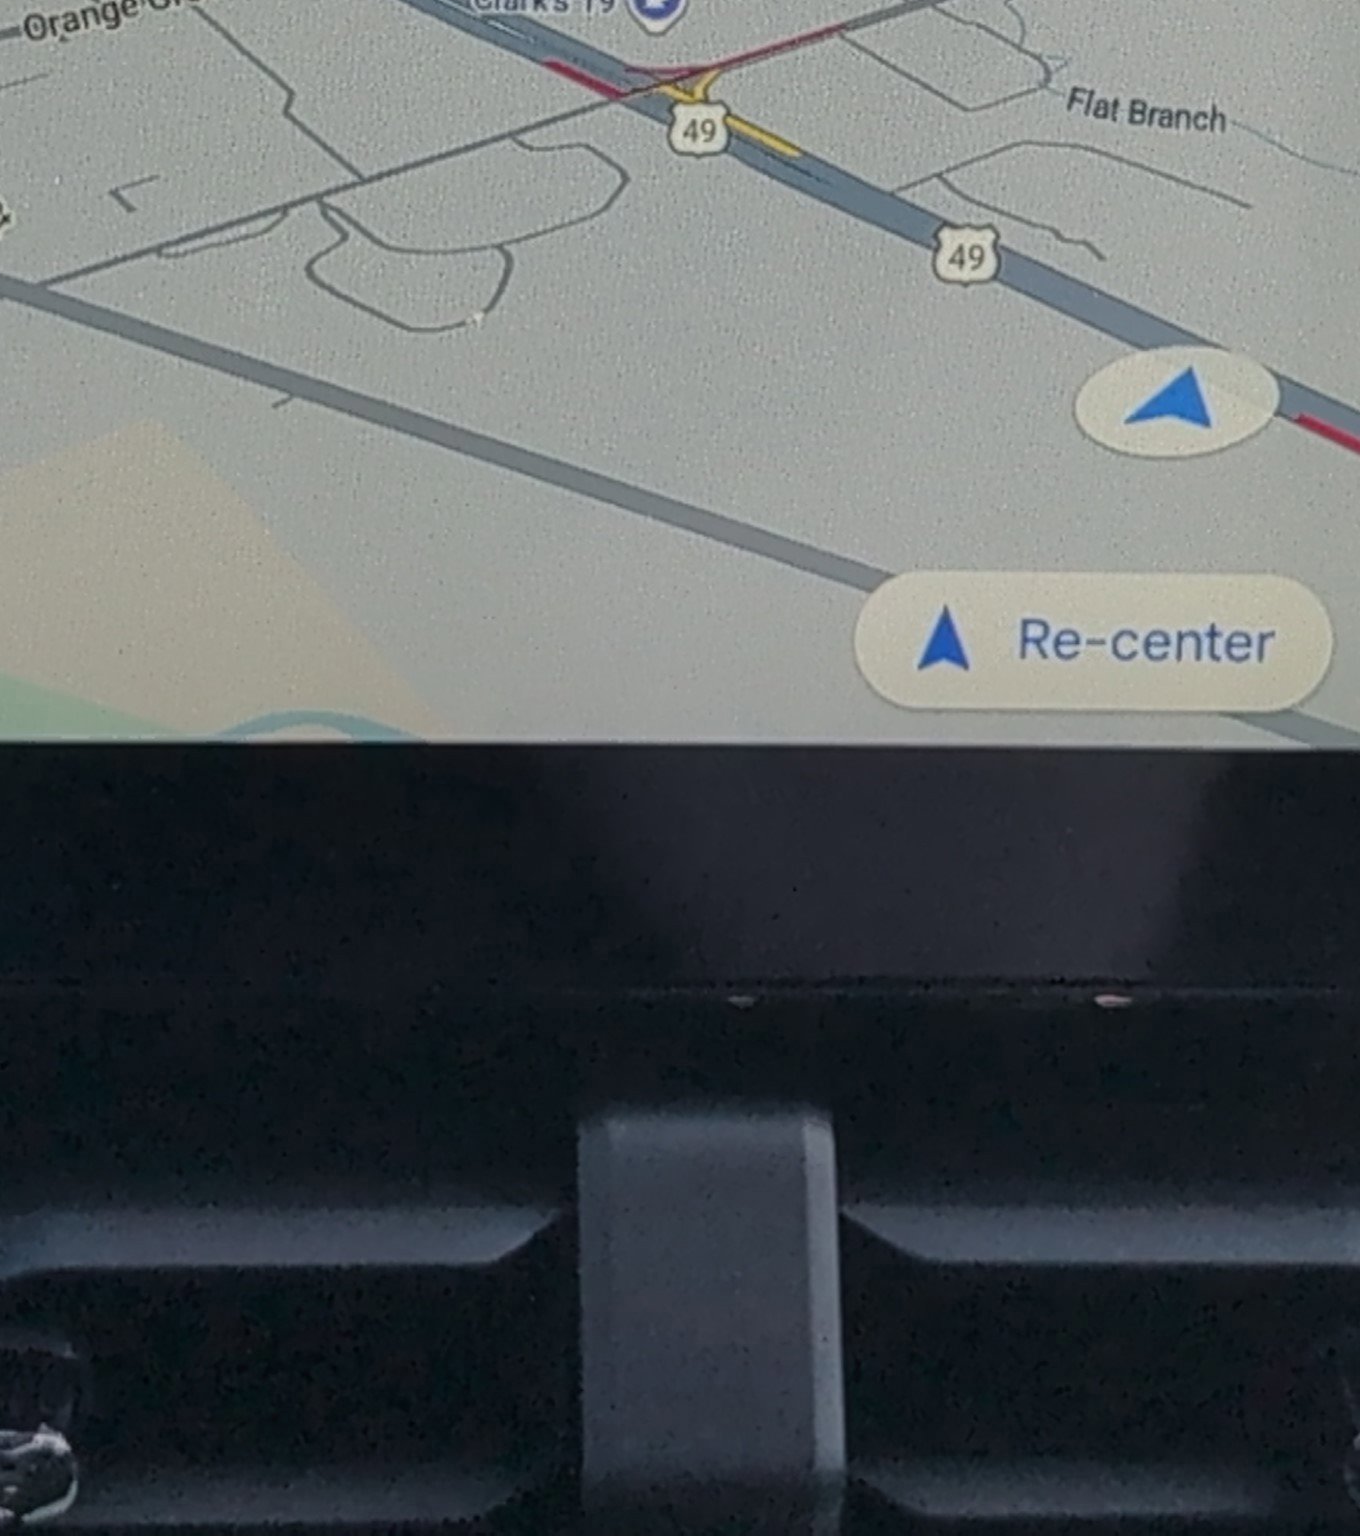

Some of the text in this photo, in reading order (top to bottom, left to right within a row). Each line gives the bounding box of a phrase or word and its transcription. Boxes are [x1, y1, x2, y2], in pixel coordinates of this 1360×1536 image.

[1066, 85, 1228, 134] Flat Branch
[681, 117, 719, 144] 49
[947, 243, 986, 273] 49
[1018, 617, 1278, 663] Re-center
